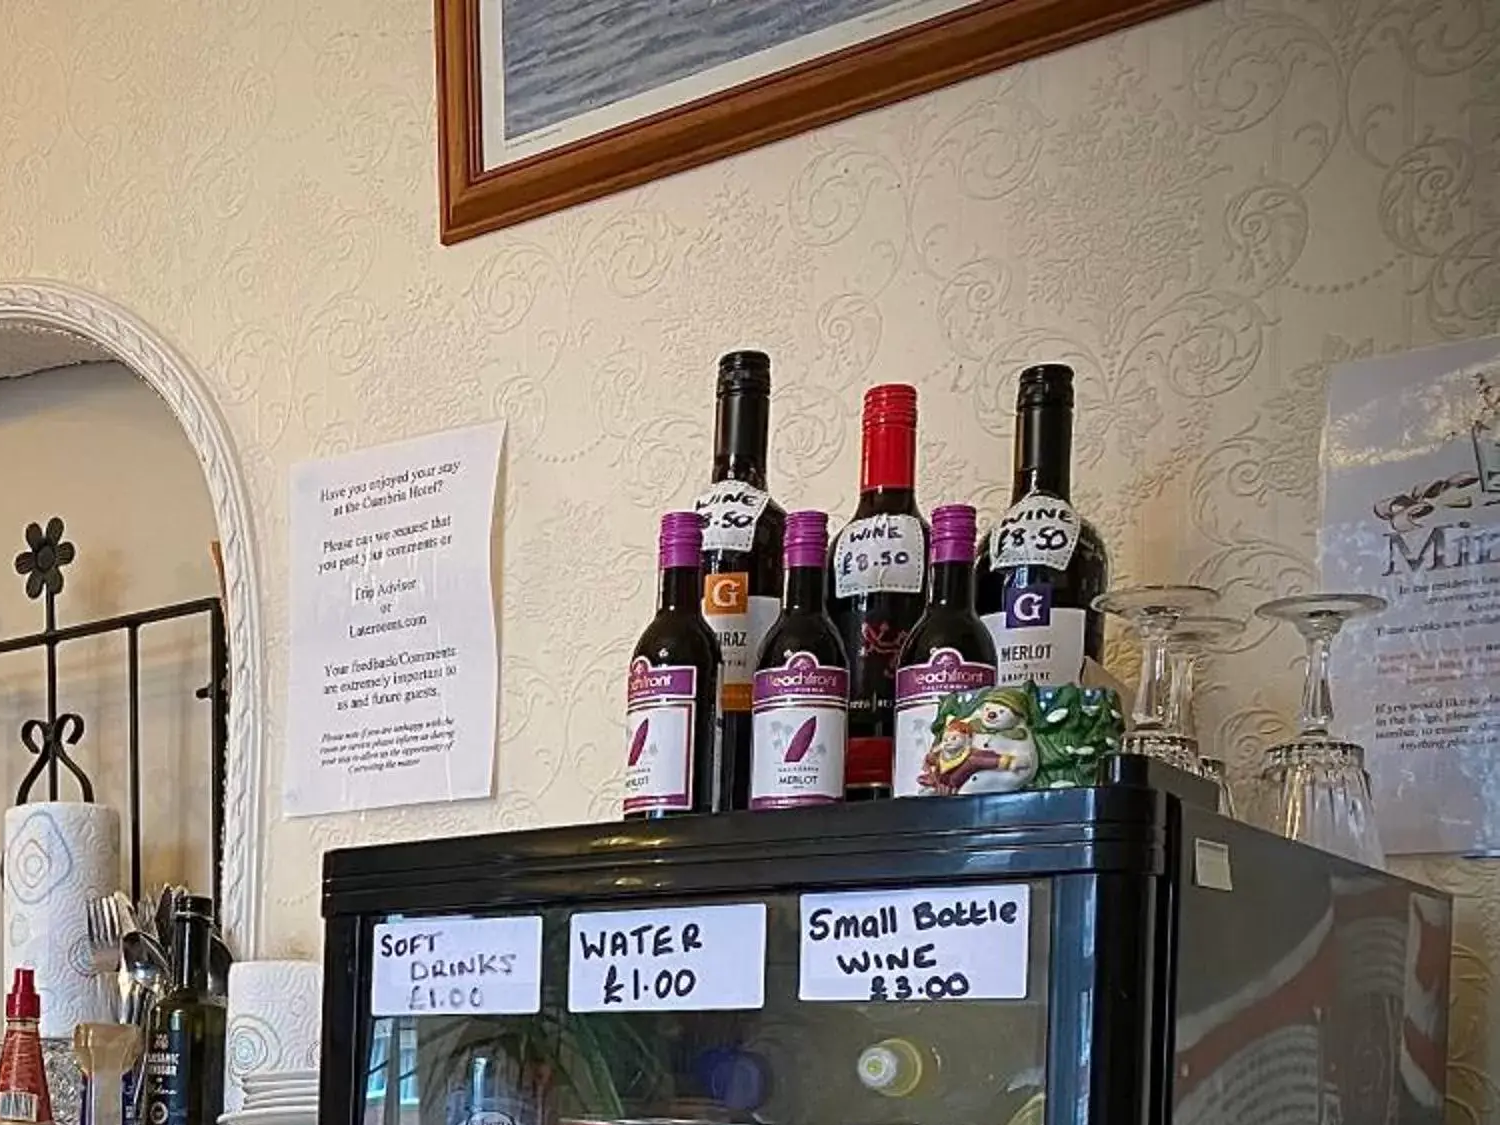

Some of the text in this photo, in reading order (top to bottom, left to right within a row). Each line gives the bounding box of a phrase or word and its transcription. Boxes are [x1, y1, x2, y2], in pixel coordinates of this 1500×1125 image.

[321, 460, 461, 502] Have you enjoyed your stay
[333, 480, 444, 516] at the Cumbria Hotel?
[323, 537, 353, 554] Please
[430, 514, 452, 530] that
[850, 523, 903, 542] WINE
[317, 557, 337, 575] you
[361, 548, 384, 566] yur
[385, 537, 438, 557] comments
[842, 551, 909, 576] £8.50
[355, 586, 374, 601] Trip
[712, 579, 741, 607] G
[1013, 593, 1044, 621] G
[379, 602, 392, 614] or
[1001, 644, 1051, 662] MERLOT
[323, 662, 350, 678] Your
[340, 673, 391, 693] extremely
[393, 668, 443, 687] important
[350, 693, 369, 709] and
[779, 775, 818, 785] MERLOT
[808, 900, 1018, 941] Small Bottle
[381, 931, 444, 957] SOFT
[579, 923, 703, 960] WATER
[410, 953, 517, 982] DRINKS
[836, 943, 937, 975] WINE
[409, 985, 485, 1011] £1.00
[603, 964, 697, 1005] £1.00
[870, 972, 970, 1001] £3.00
